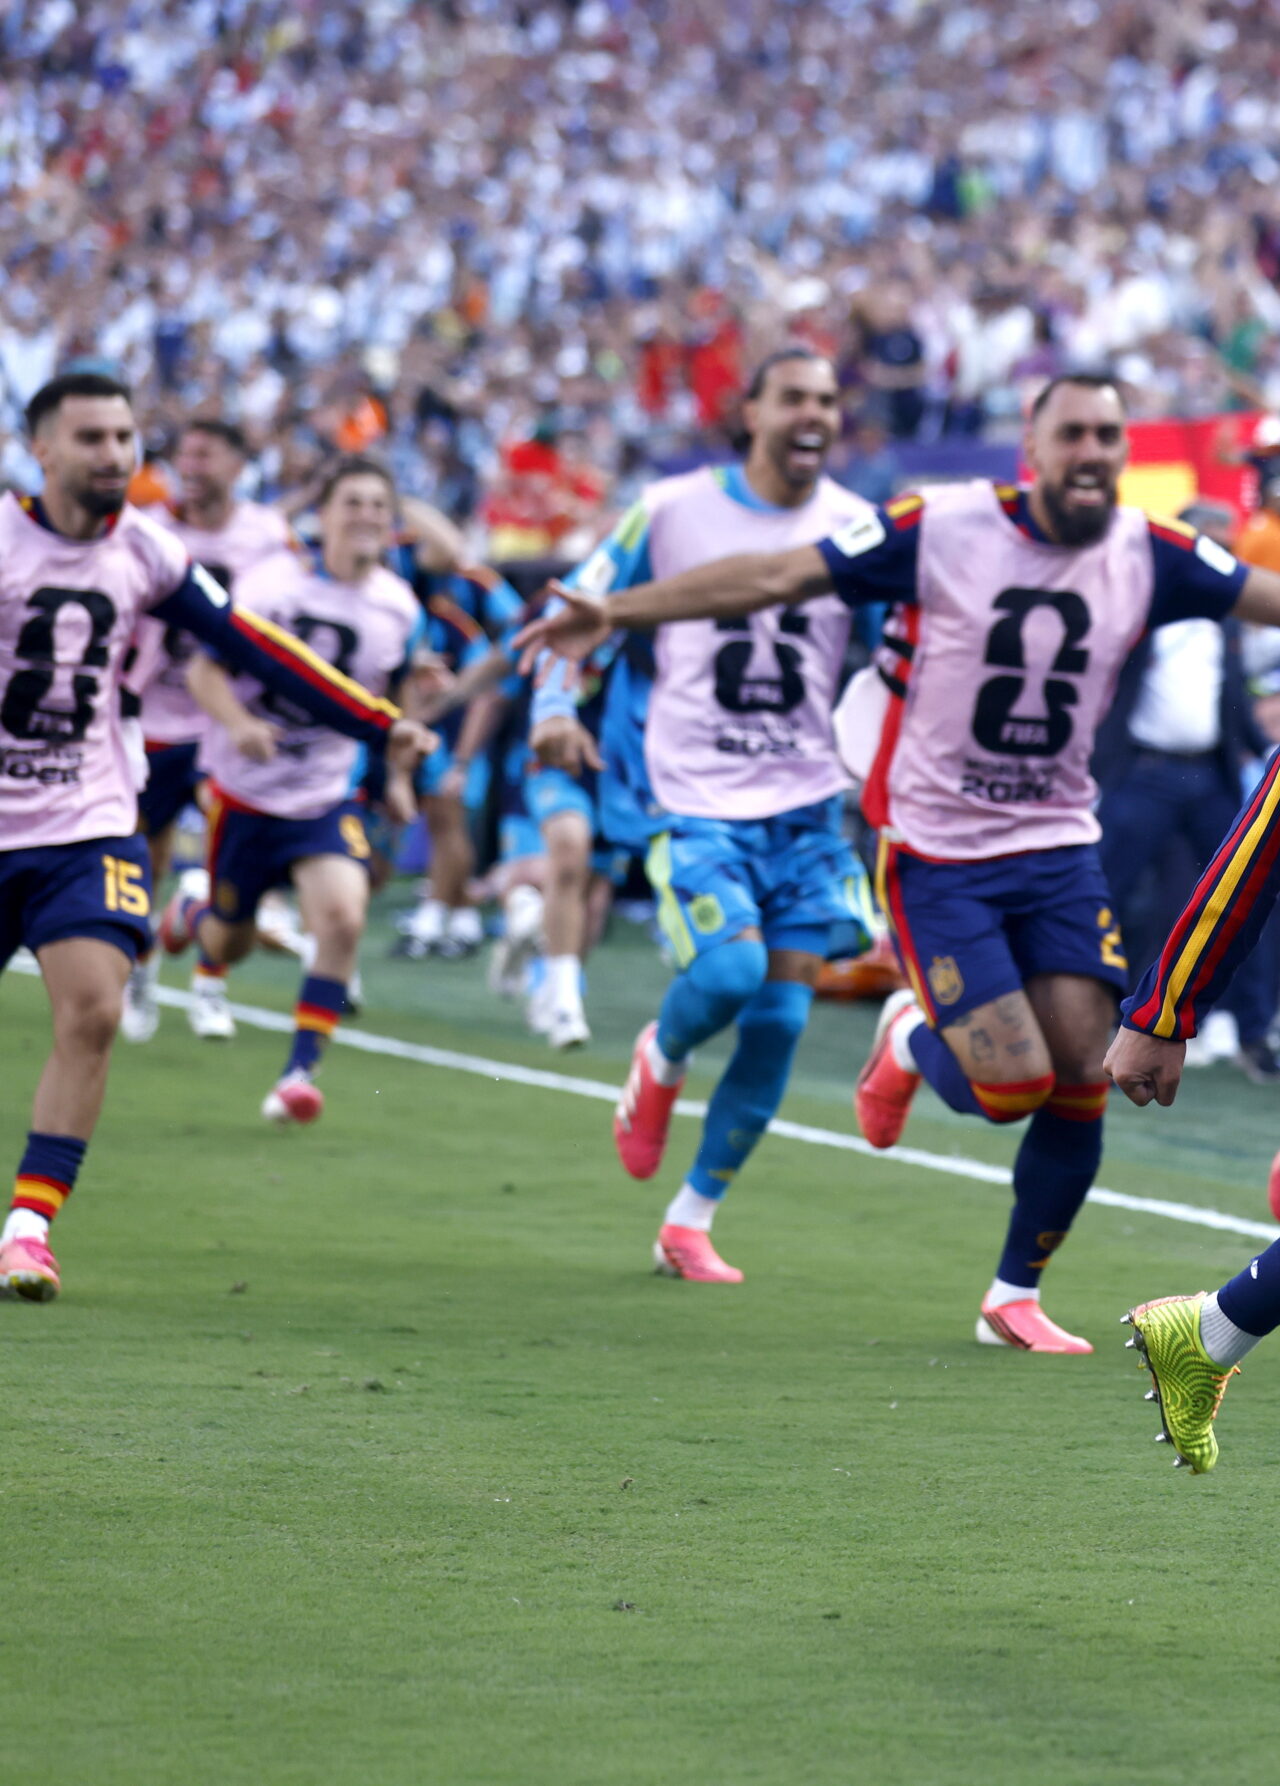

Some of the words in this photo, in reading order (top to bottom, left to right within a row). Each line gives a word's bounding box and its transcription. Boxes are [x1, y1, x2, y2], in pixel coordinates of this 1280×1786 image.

[1001, 720, 1049, 746] FIFA
[961, 773, 1053, 802] 2026
[102, 854, 150, 917] 15
